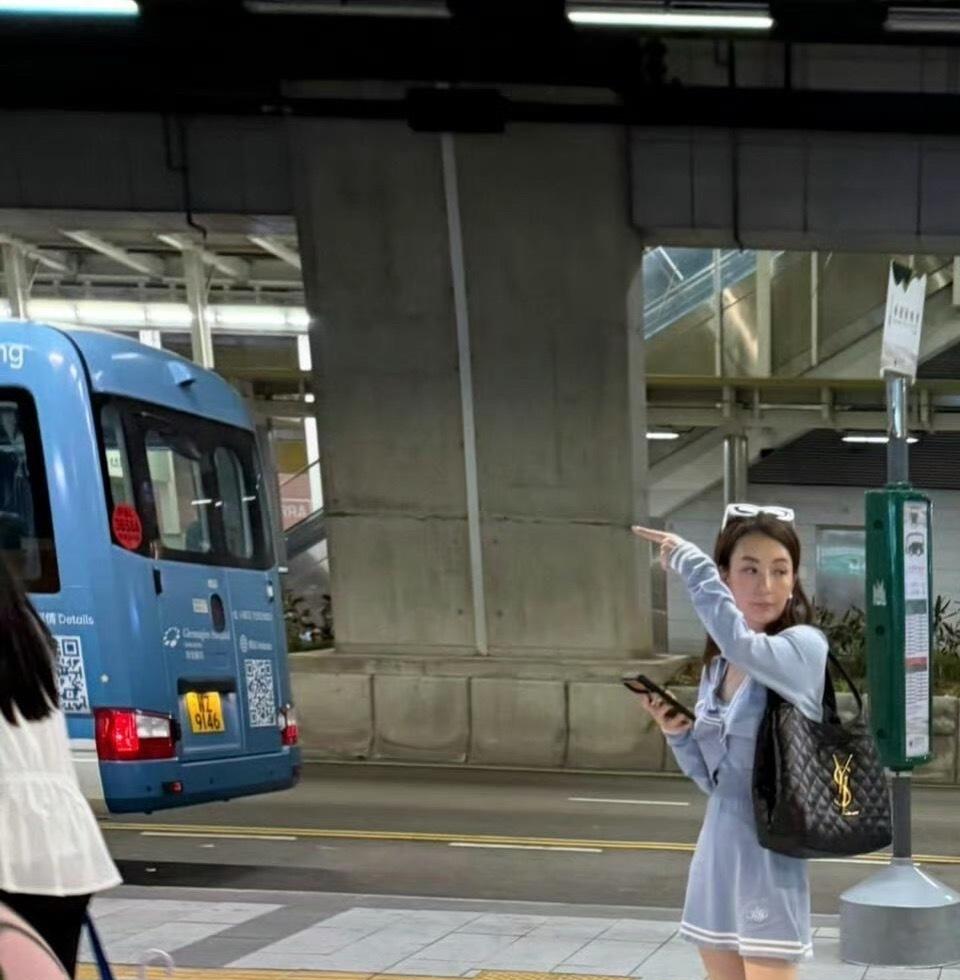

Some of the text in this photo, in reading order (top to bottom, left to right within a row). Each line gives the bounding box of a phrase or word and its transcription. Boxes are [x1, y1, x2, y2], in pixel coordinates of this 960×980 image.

[58, 614, 95, 625] Details
[195, 712, 220, 729] 9146
[833, 753, 860, 816] YSL
